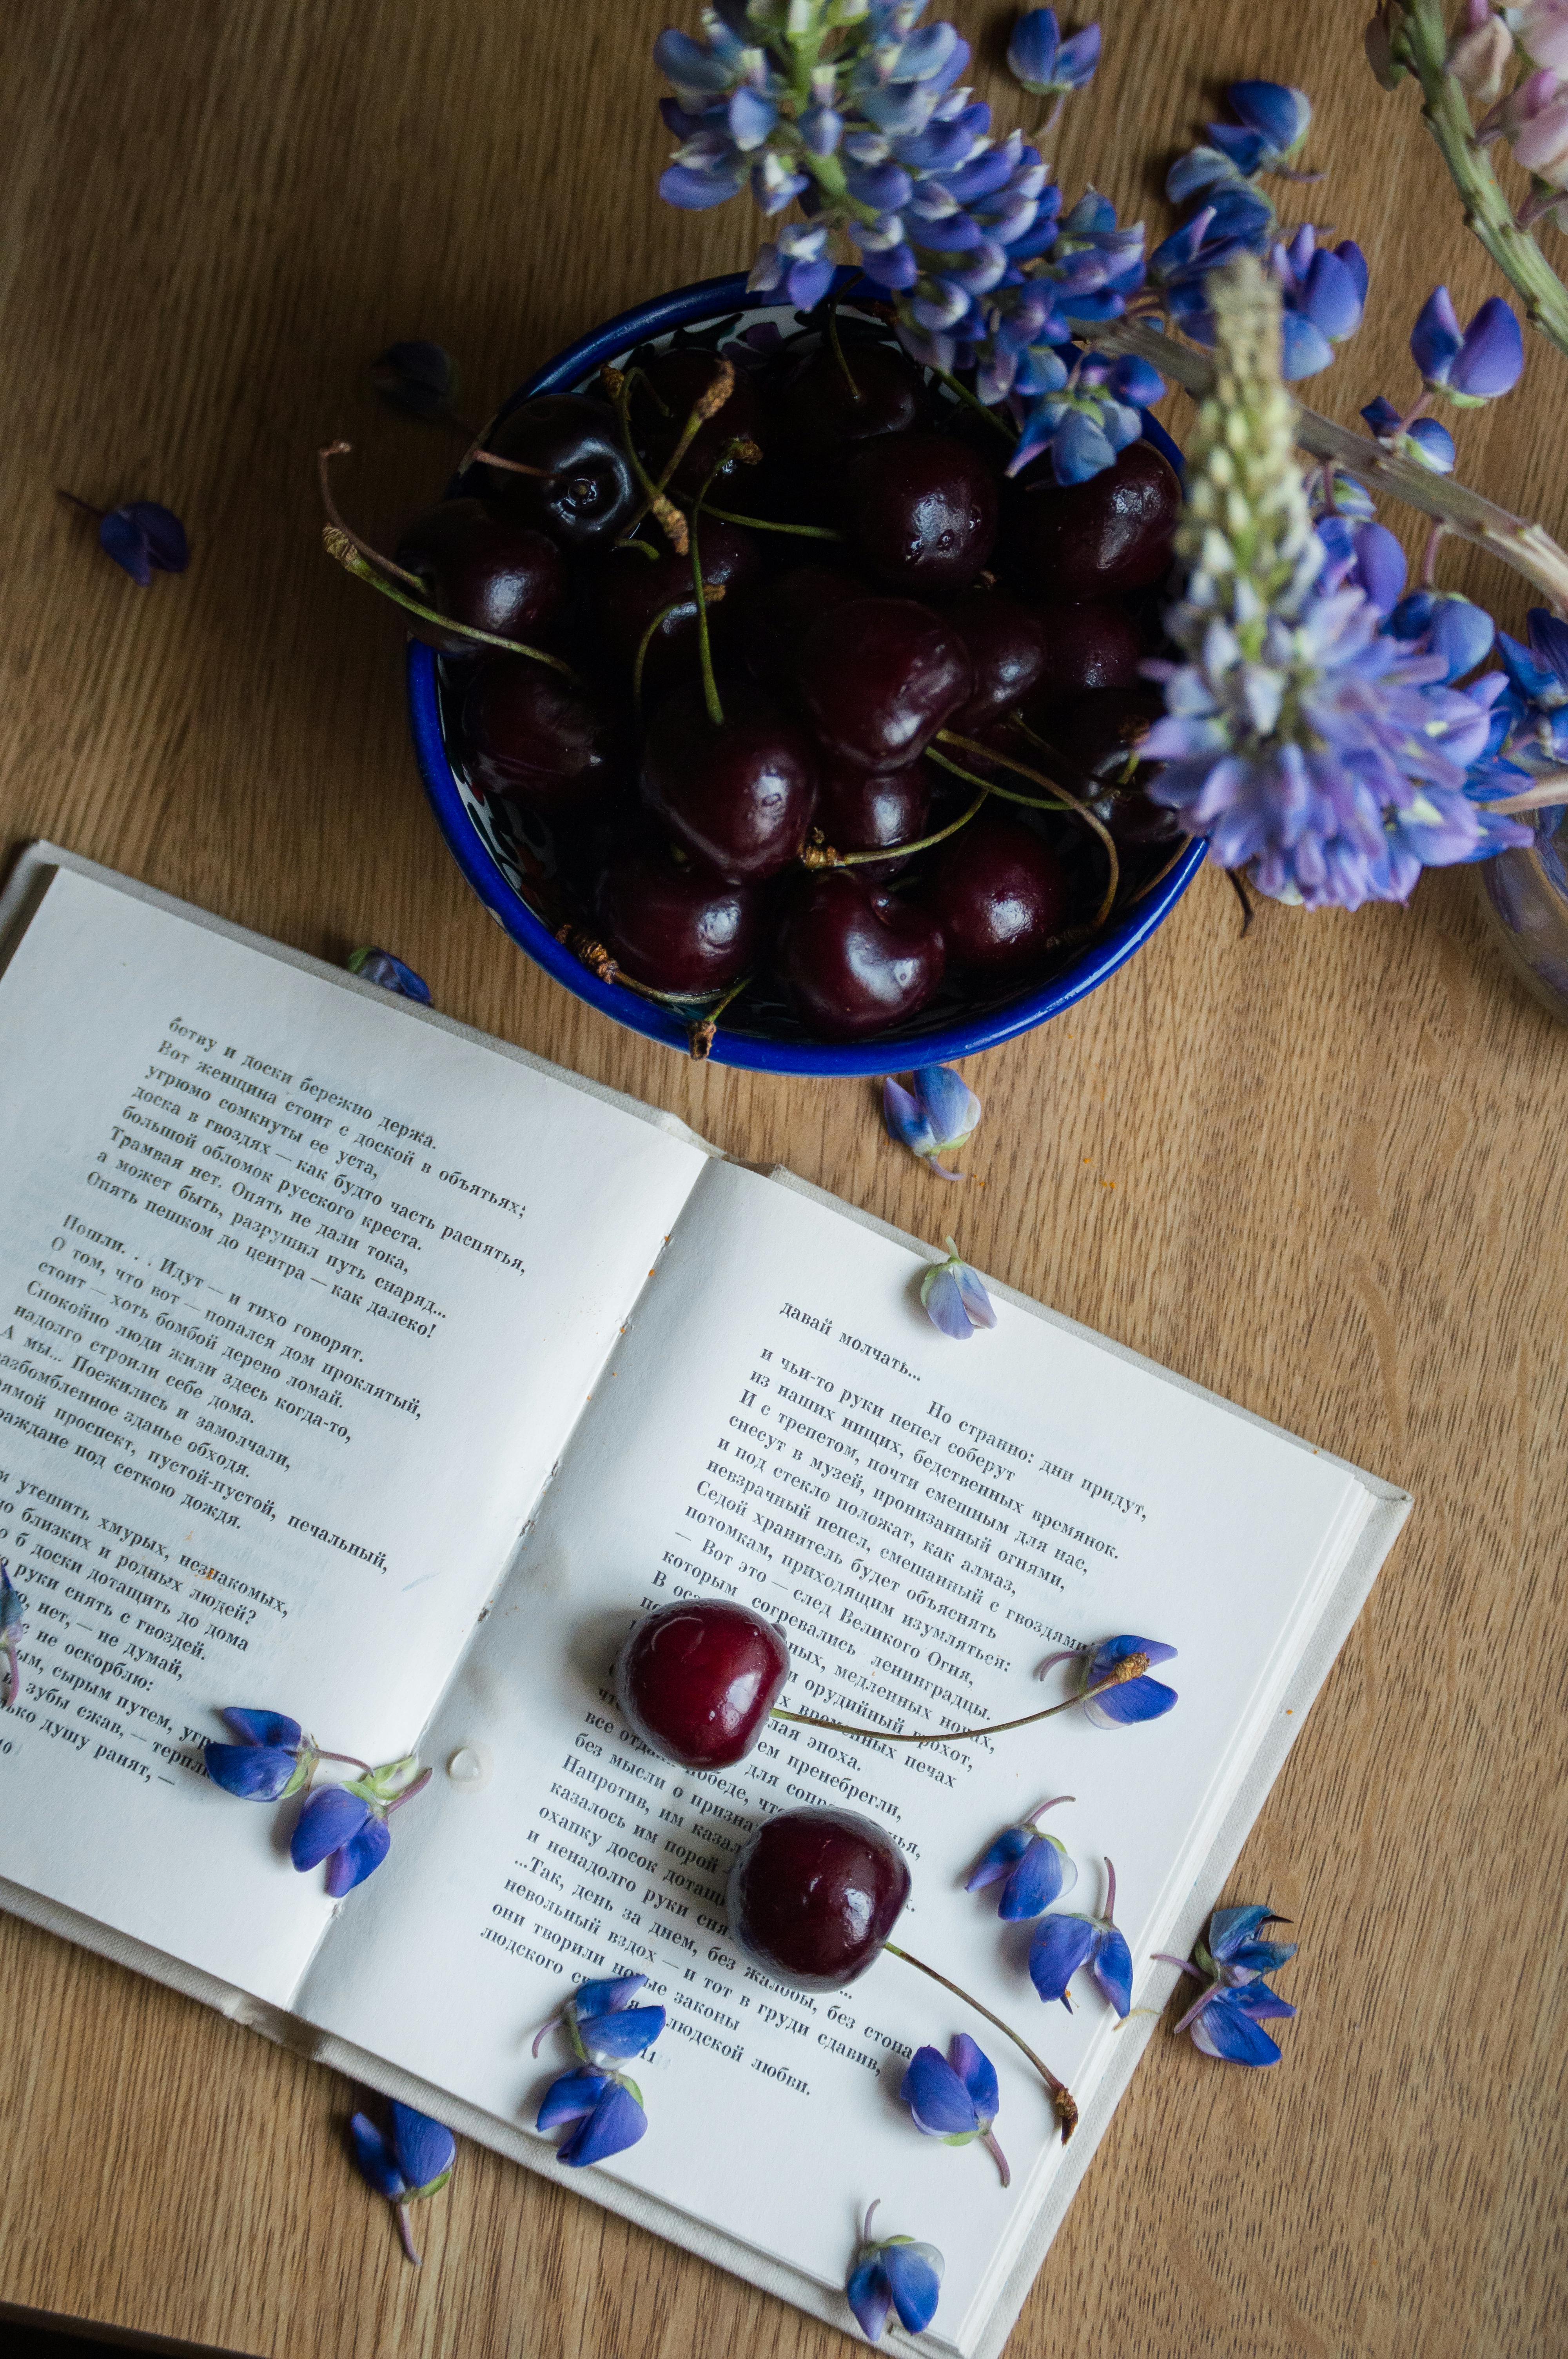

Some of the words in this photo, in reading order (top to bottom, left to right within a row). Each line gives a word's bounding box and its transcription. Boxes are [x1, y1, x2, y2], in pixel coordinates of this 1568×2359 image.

[144, 1065, 212, 1101] угрюмо
[218, 1098, 304, 1143] сомкнуты
[309, 1139, 329, 1155] ее
[334, 1150, 377, 1181] уста,
[157, 1040, 191, 1064] Вот
[195, 1061, 278, 1105] женщина
[284, 1101, 333, 1129] стоит
[338, 1125, 350, 1137] с
[352, 1132, 416, 1167] доской
[420, 1162, 432, 1174] в
[438, 1170, 526, 1220] объятьях;
[222, 1046, 238, 1060] и
[240, 1054, 294, 1085] доски
[299, 1076, 373, 1120] бережно
[377, 1116, 436, 1150] держа.
[96, 1151, 108, 1164] а
[115, 1159, 173, 1191] может
[178, 1184, 223, 1220] быть,
[229, 1212, 319, 1259] разрушил
[325, 1254, 366, 1280] путь
[374, 1276, 446, 1319] снаряд...
[109, 1125, 185, 1170] Трамвая
[188, 1165, 222, 1189] нет.
[231, 1181, 283, 1216] Опять
[289, 1211, 312, 1228] не
[314, 1223, 360, 1250] дали
[366, 1245, 408, 1276] тока,
[122, 1105, 198, 1150] большой
[201, 1145, 274, 1184] обломок
[276, 1179, 355, 1220] русского
[360, 1216, 421, 1251] креста.
[0, 1325, 15, 1341] А
[23, 1337, 62, 1362] мы...
[70, 1354, 168, 1411] Поежились
[175, 1407, 190, 1421] и
[195, 1416, 290, 1472] замолчали,
[13, 1305, 83, 1343] надолго
[89, 1340, 160, 1379] строили
[165, 1375, 203, 1399] себе
[207, 1394, 254, 1424] дома.
[26, 1280, 110, 1328] Спокойно
[115, 1325, 163, 1353] люди
[167, 1348, 218, 1378] жили
[221, 1373, 269, 1402] здесь
[274, 1397, 351, 1445] когда-то,
[759, 1348, 774, 1362] и
[781, 1357, 835, 1393] чьи-то
[838, 1388, 885, 1418] руки
[888, 1412, 942, 1447] пепел
[947, 1442, 1016, 1481] соберут
[779, 1302, 833, 1336] давай
[838, 1332, 921, 1382] молчать...
[53, 1407, 136, 1457] проспект,
[147, 1450, 276, 1522] пустой-пустой,
[286, 1515, 388, 1575] печальный,
[73, 1444, 107, 1470] под
[113, 1462, 176, 1498] сеткою
[179, 1493, 241, 1530] дождя.
[123, 1410, 183, 1446] зданье
[187, 1441, 250, 1478] обходя.
[728, 1415, 787, 1452] снесут
[791, 1448, 804, 1461] в
[809, 1456, 865, 1496] музей,
[872, 1487, 992, 1554] пронизанный
[997, 1550, 1065, 1593] огнями,
[738, 1389, 758, 1408] И
[760, 1404, 771, 1416] с
[777, 1412, 860, 1466] трепетом,
[866, 1458, 920, 1491] почти
[925, 1487, 1010, 1535] смешным
[1013, 1530, 1049, 1553] для
[1053, 1548, 1088, 1576] нас,
[749, 1370, 771, 1388] из
[777, 1384, 836, 1422] наших
[840, 1416, 904, 1460] нищих,
[913, 1448, 1025, 1514] бедственных
[1031, 1510, 1118, 1560] времянок.
[926, 1400, 952, 1424] Но
[958, 1420, 1034, 1464] странно:
[1038, 1459, 1074, 1483] дни
[1080, 1478, 1147, 1523] придут,
[15, 1479, 90, 1521] утешить
[96, 1517, 170, 1563] хмурых,
[178, 1554, 288, 1619] незнакомых,
[20, 1507, 92, 1551] близких
[97, 1545, 112, 1560] и
[114, 1554, 184, 1593] родных
[189, 1588, 257, 1625] людей?
[684, 1505, 773, 1562] потомкам,
[780, 1554, 895, 1618] приходящим
[900, 1613, 1011, 1672] изумляться:
[696, 1480, 749, 1517] Седой
[751, 1512, 843, 1565] хранитель
[850, 1558, 901, 1592] будет
[906, 1589, 997, 1639] объяснять
[705, 1459, 811, 1521] невзрачный
[815, 1516, 871, 1555] пепел,
[880, 1547, 984, 1605] смешанный
[989, 1601, 1000, 1613] с
[717, 1437, 731, 1452] и
[734, 1447, 768, 1473] под
[773, 1467, 831, 1503] стекло
[835, 1497, 915, 1549] положат,
[922, 1540, 955, 1564] как
[960, 1559, 1016, 1598] алмаз,
[12, 1563, 60, 1591] руки
[64, 1586, 113, 1617] снять
[119, 1612, 132, 1624] с
[135, 1618, 205, 1661] гвоздей.
[15, 1531, 31, 1548] б
[29, 1543, 84, 1574] доски
[85, 1568, 171, 1615] дотащить
[176, 1611, 200, 1628] до
[203, 1623, 249, 1652] дома
[661, 1550, 739, 1597] которым
[751, 1597, 856, 1656] согревались
[870, 1656, 991, 1721] ленинградцы.
[561, 1754, 650, 1816] Напротив,
[657, 1807, 684, 1828] им
[574, 1732, 603, 1757] без
[608, 1753, 667, 1790] мысли
[672, 1786, 684, 1799] о
[526, 1829, 541, 1844] и
[546, 1840, 637, 1892] ненадолго
[641, 1888, 690, 1918] руки
[539, 1807, 603, 1848] охапку
[605, 1841, 659, 1874] досок
[480, 1927, 564, 1974] людского
[666, 2017, 745, 2063] людской
[750, 2058, 810, 2096] любви.
[492, 1903, 526, 1927] они
[534, 1923, 606, 1967] творили
[611, 1959, 669, 1998] ноые
[673, 1991, 740, 2031] законы
[503, 1878, 602, 1936] невольный
[606, 1931, 657, 1964] вздох
[682, 1968, 697, 1983] и
[703, 1977, 733, 1998] тот
[739, 1994, 751, 2008] в
[756, 2003, 811, 2037] груди
[817, 2033, 881, 2077] сдавив,
[514, 1856, 564, 1892] ...Так,
[571, 1884, 613, 1912] день
[621, 1908, 641, 1926] за
[647, 1921, 698, 1958] днем,
[707, 1946, 737, 1971] без
[827, 2005, 856, 2030] без
